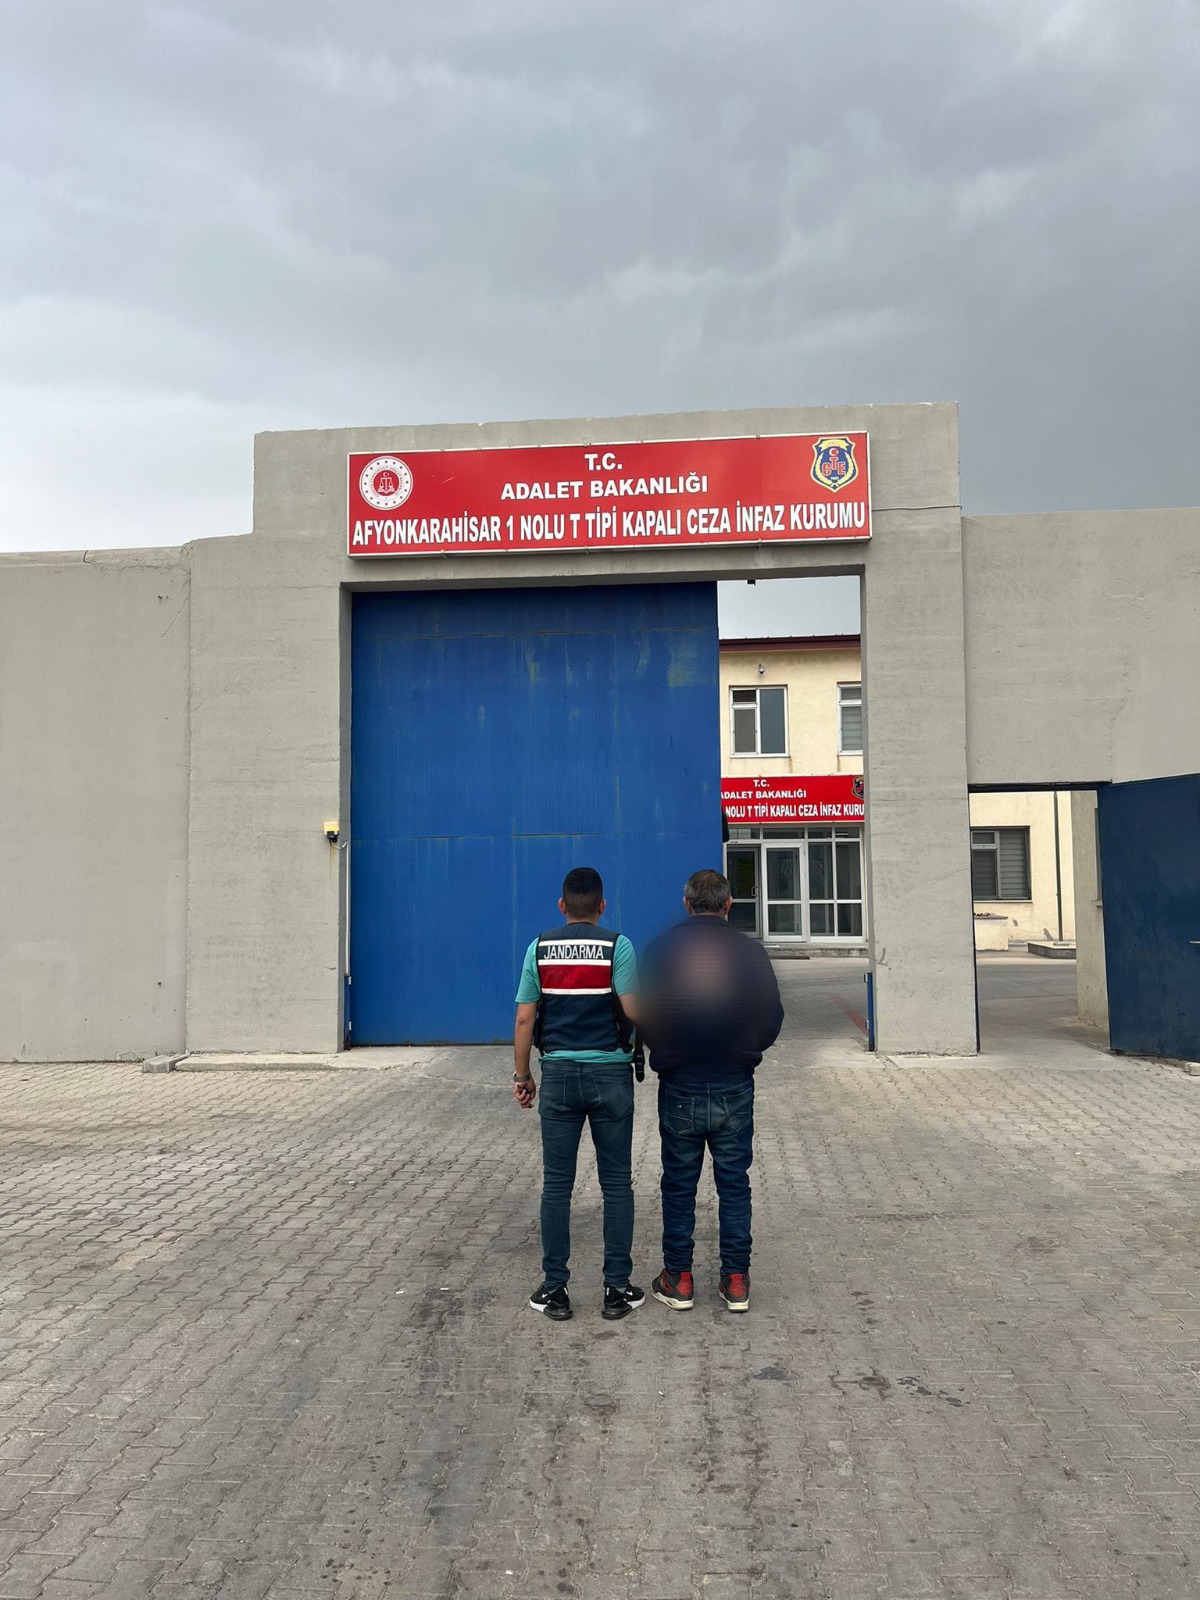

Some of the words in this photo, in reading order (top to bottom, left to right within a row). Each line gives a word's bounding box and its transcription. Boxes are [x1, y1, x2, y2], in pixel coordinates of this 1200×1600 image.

[584, 452, 623, 471] T.C.
[501, 481, 583, 500] ADALET
[590, 472, 708, 497] BAKANLIĞI
[352, 510, 502, 546] AFYONKARAHİSAR
[506, 515, 514, 541] 1
[520, 514, 565, 540] NOLU
[570, 513, 581, 539] T
[585, 505, 617, 538] TİPİ
[622, 509, 682, 537] KAPALI
[686, 507, 731, 535] CEZA
[736, 500, 785, 532] İNFAZ
[790, 501, 866, 530] KURUMU
[753, 779, 770, 787] T.C.
[755, 789, 806, 799] BAKANLIĞI
[726, 805, 746, 817] NOLU
[747, 805, 753, 817] T
[754, 802, 769, 817] TİPİ
[770, 804, 797, 817] KAPALI
[798, 804, 818, 816] CEZA
[819, 801, 842, 816] İNFAZ
[543, 945, 604, 960] JANDARMA
